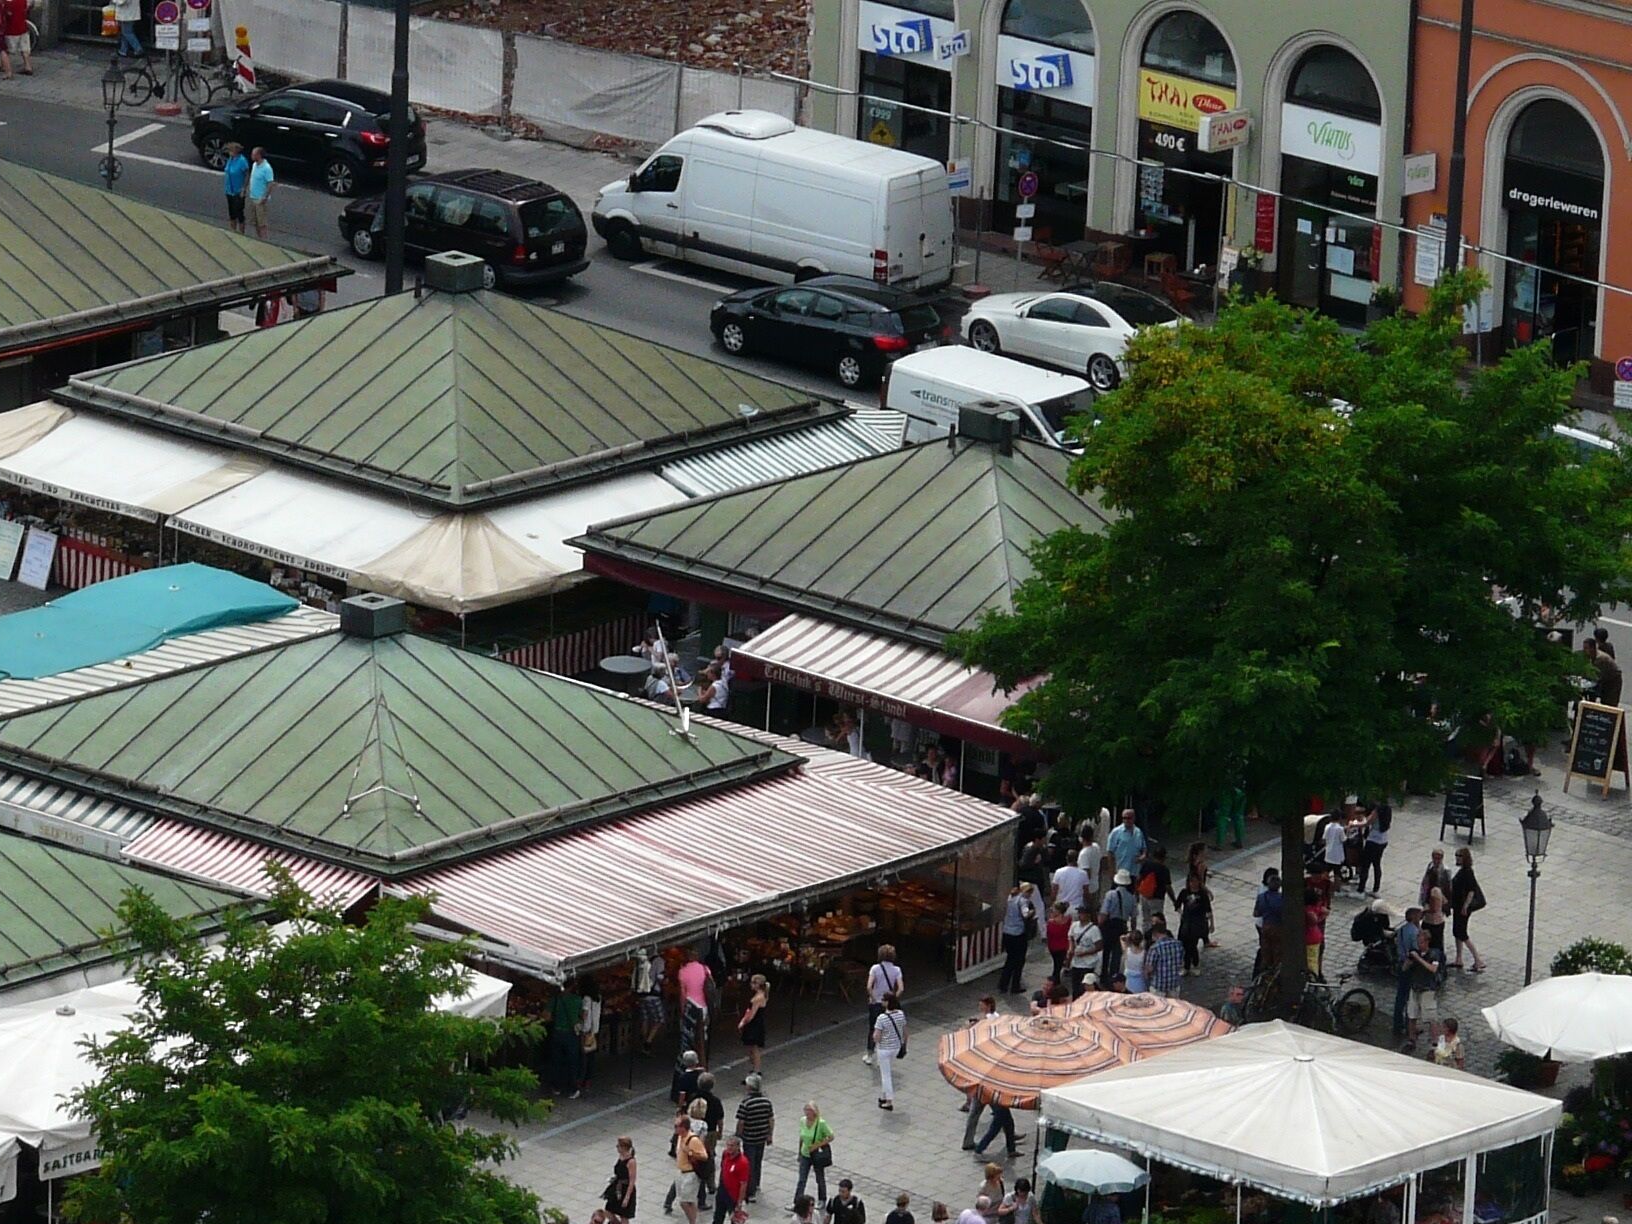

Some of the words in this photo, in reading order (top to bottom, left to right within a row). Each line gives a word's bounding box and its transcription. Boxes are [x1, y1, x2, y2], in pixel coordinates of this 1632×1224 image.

[872, 24, 921, 54] sta
[1011, 59, 1061, 89] sta
[1146, 77, 1188, 111] THAI
[1509, 187, 1598, 220] drogeriewaren
